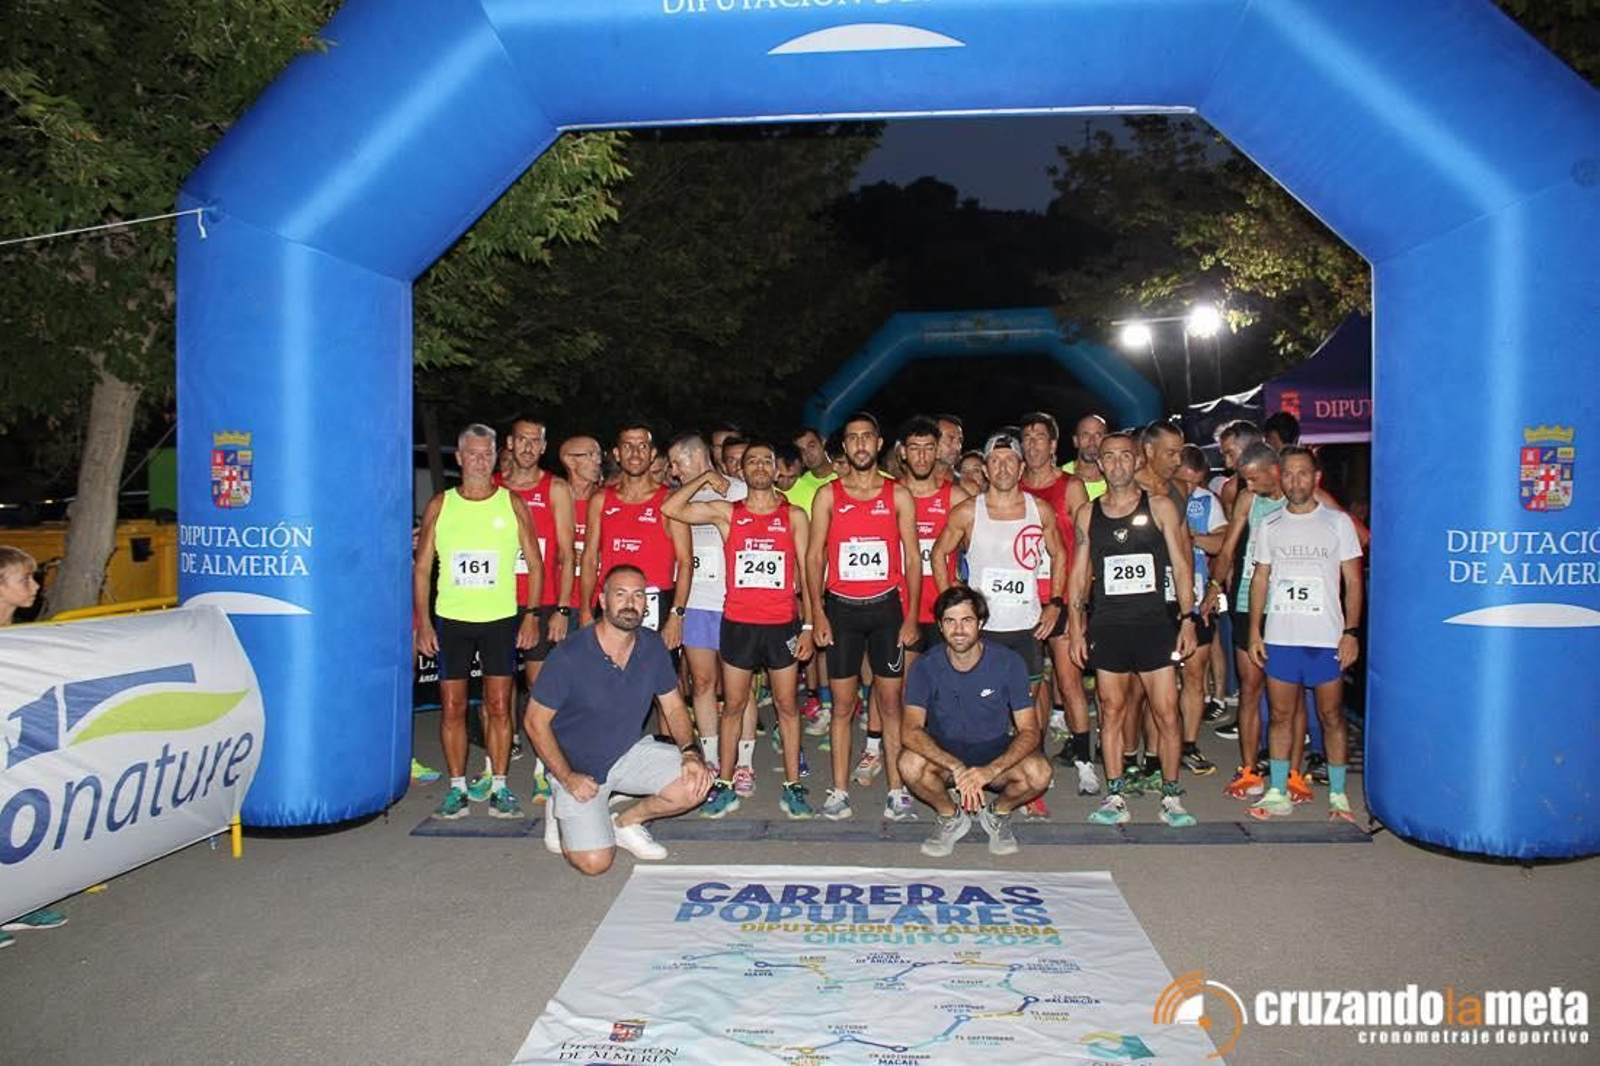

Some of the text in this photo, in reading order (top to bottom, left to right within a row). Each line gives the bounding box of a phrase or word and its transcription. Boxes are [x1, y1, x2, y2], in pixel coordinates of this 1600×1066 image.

[179, 521, 313, 548] DIPUTACIÓN
[181, 552, 310, 577] DE ALMERÍA
[458, 560, 490, 573] 161
[849, 552, 881, 566] 204
[744, 561, 777, 575] 249
[1113, 565, 1146, 580] 289
[1449, 560, 1600, 586] DE ALMER
[991, 580, 1025, 594] 540
[1286, 586, 1309, 601] 15
[686, 882, 1044, 905] CARRERAS
[674, 902, 1053, 926] POPULARES
[903, 924, 932, 934] DE
[803, 931, 1062, 946] CIRCUITO 2024
